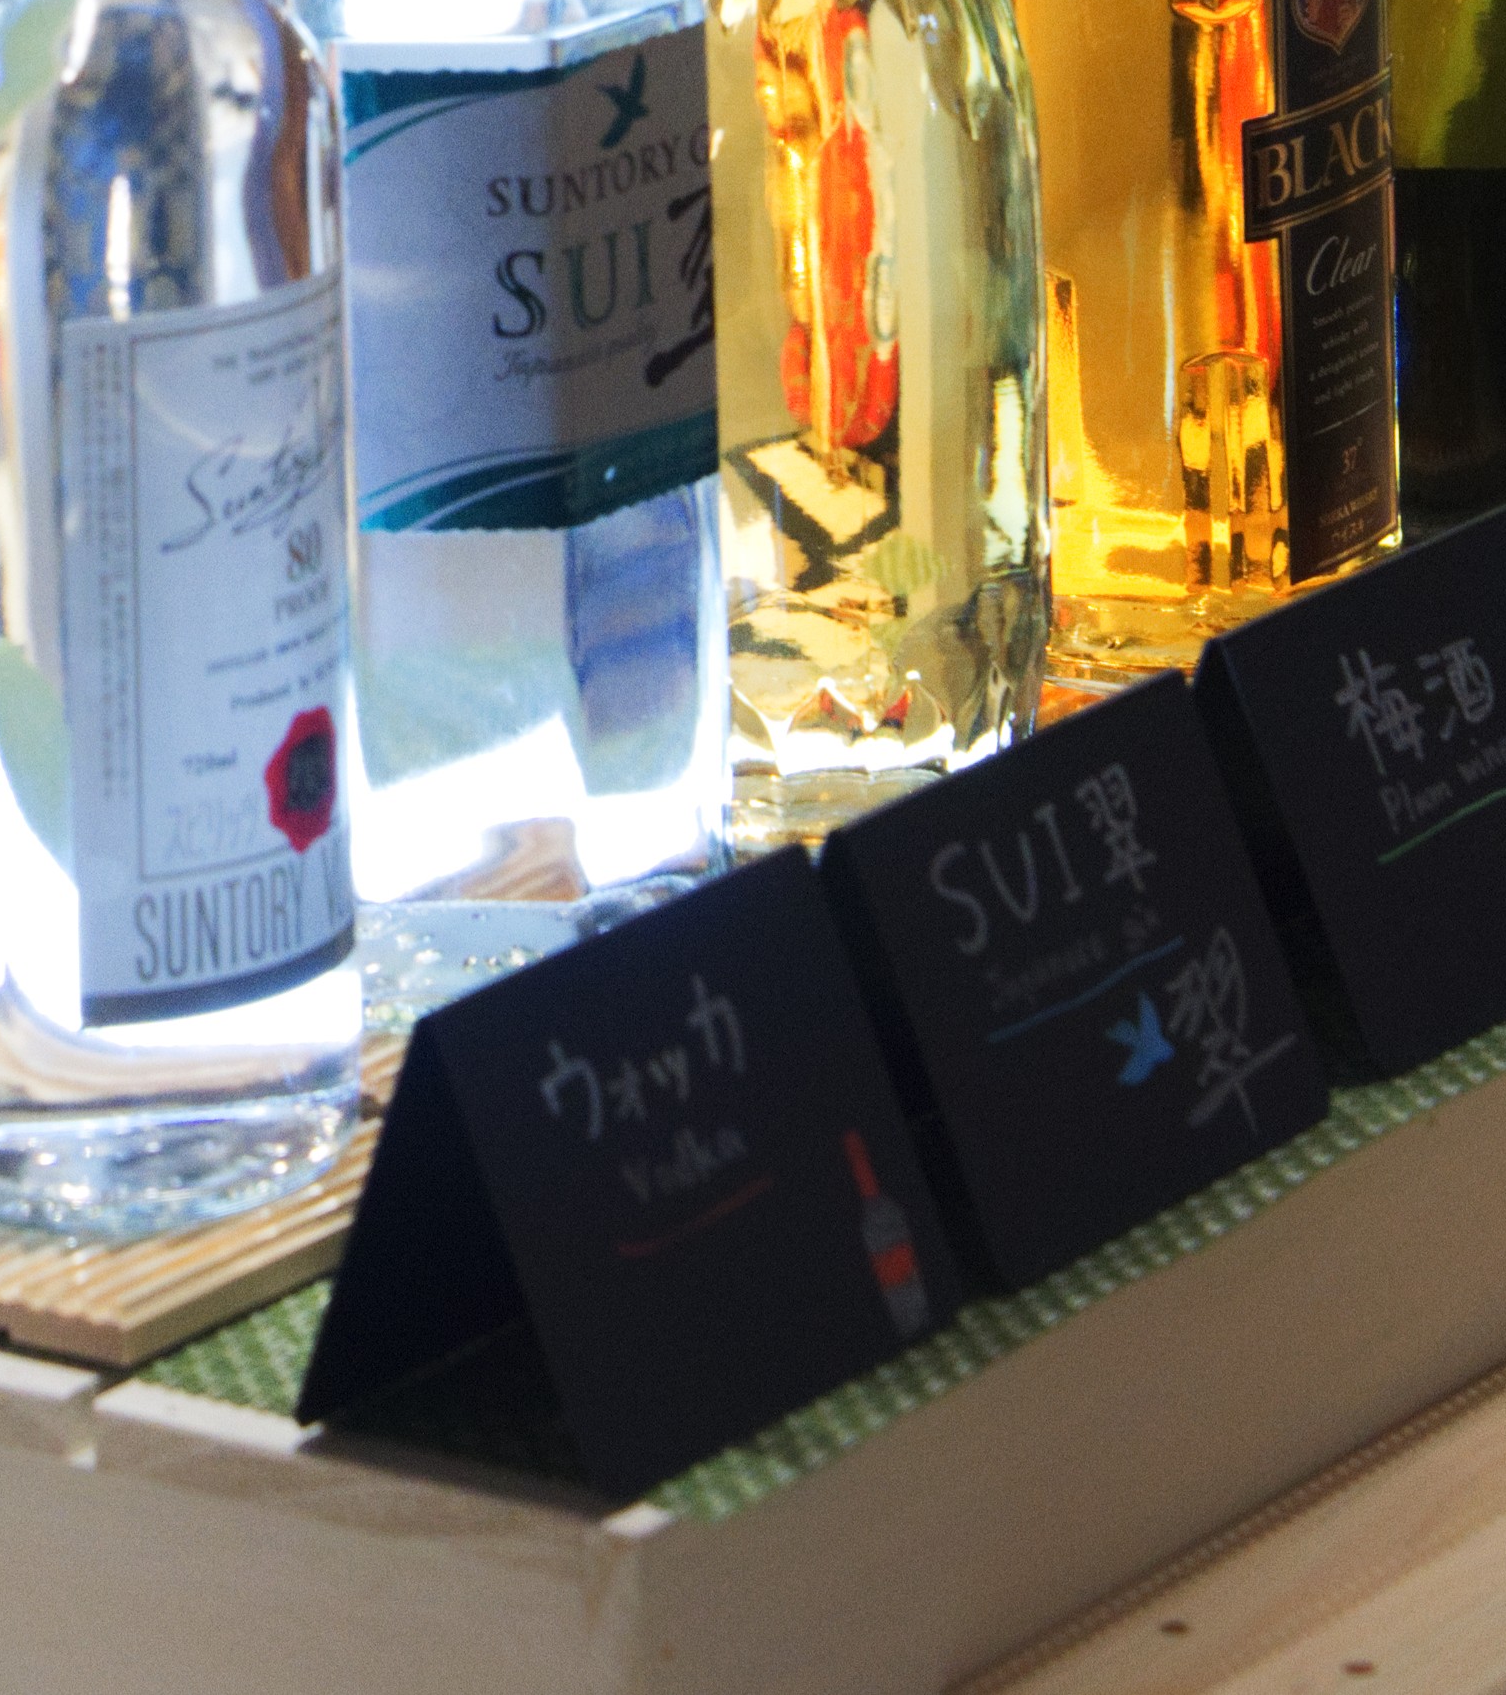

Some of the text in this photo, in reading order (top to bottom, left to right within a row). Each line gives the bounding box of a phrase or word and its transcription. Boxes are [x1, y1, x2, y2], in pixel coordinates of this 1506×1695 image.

[487, 135, 681, 218] SUNTORY
[492, 219, 655, 341] SUI
[1305, 234, 1379, 297] Clear
[287, 520, 323, 583] 80
[1334, 637, 1496, 777] 梅酒
[135, 853, 306, 983] SUNTORY
[539, 972, 748, 1142] ウォッカ
